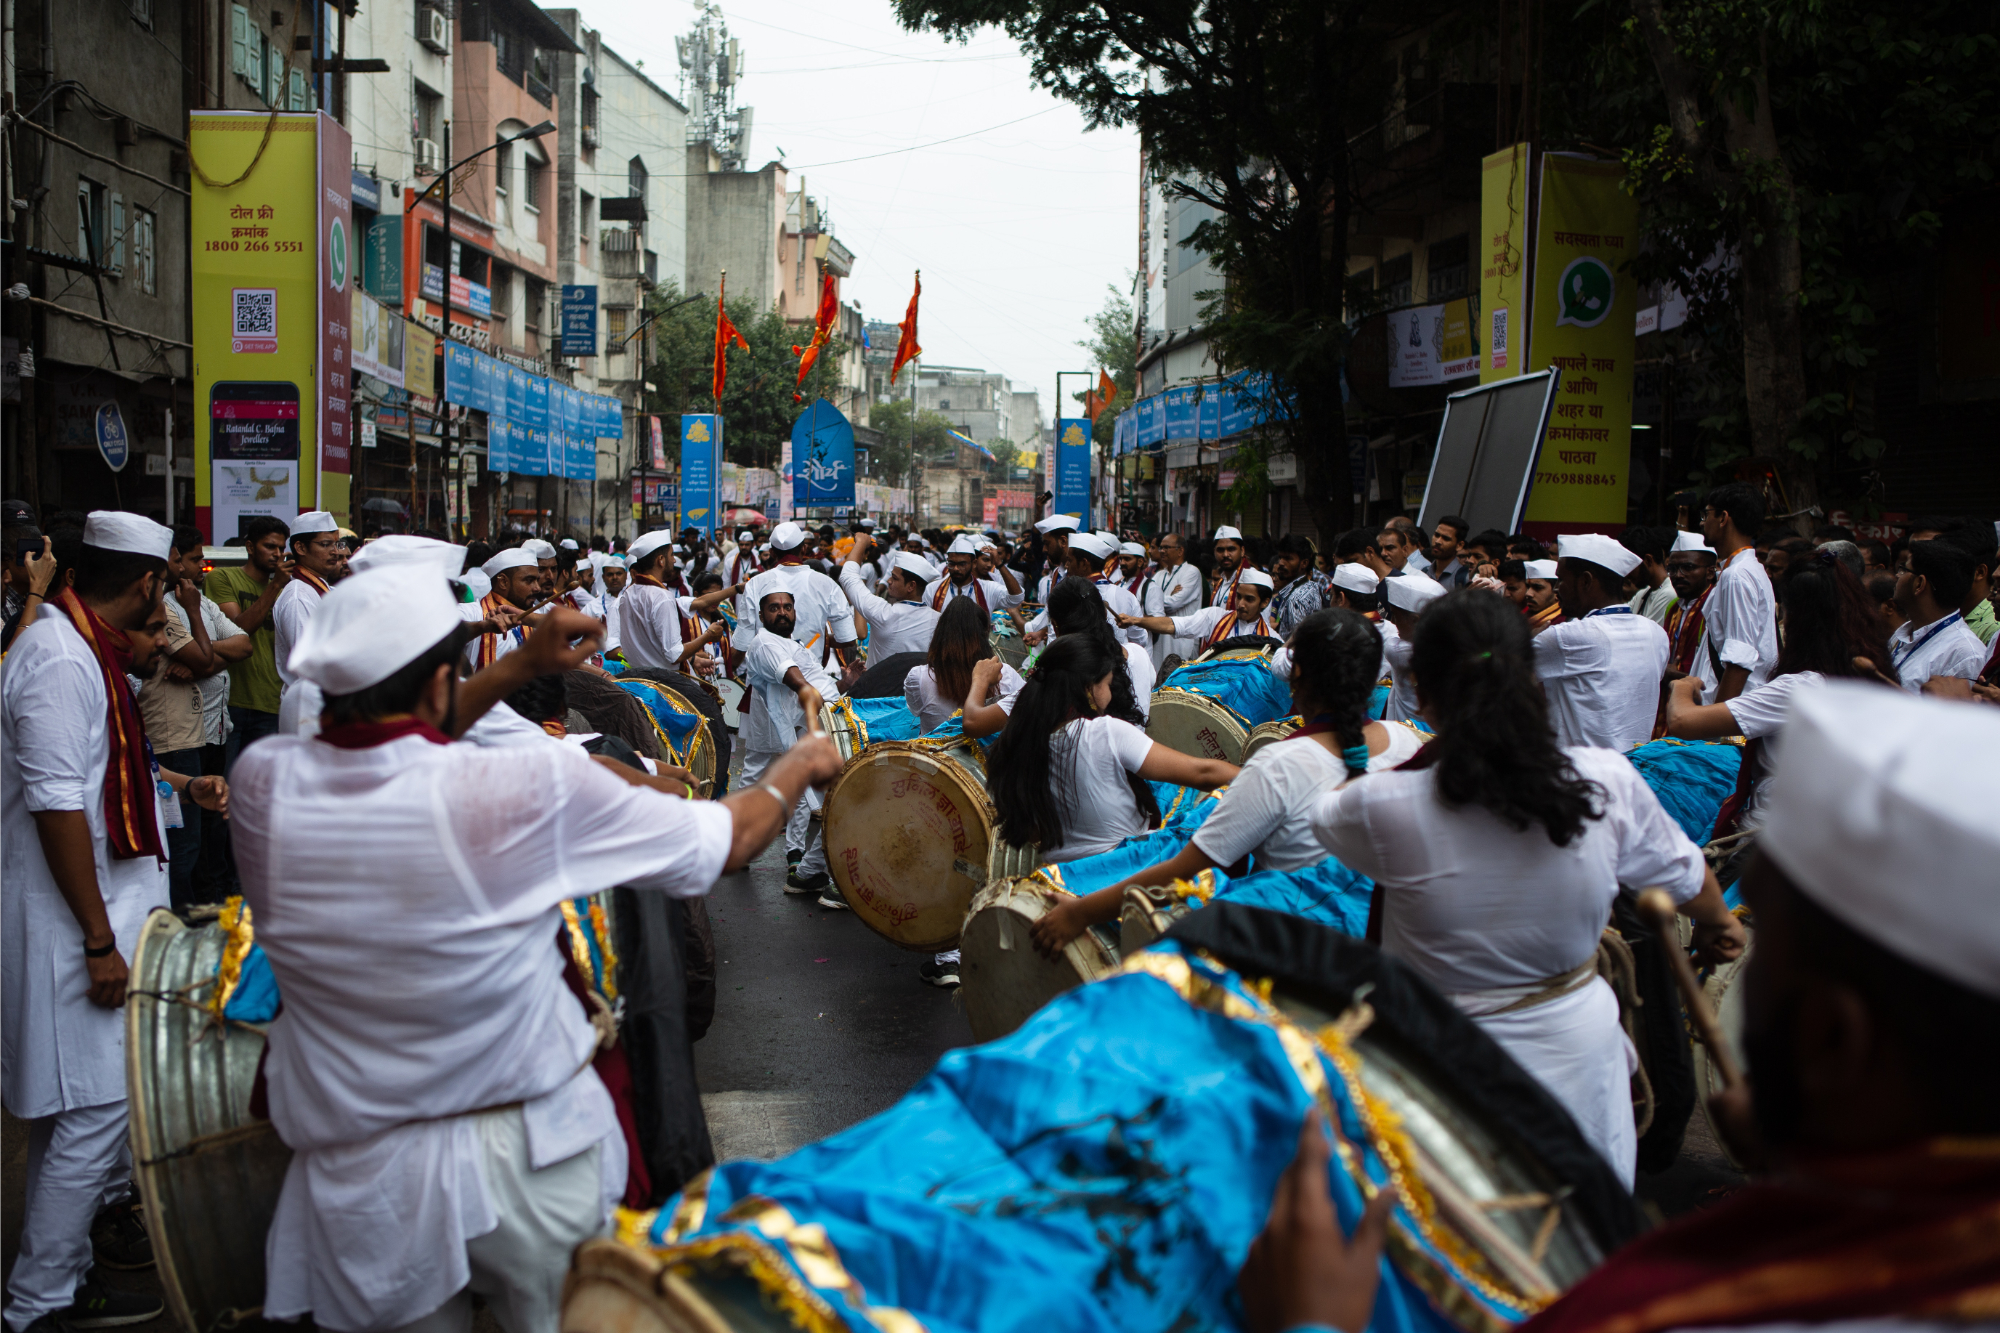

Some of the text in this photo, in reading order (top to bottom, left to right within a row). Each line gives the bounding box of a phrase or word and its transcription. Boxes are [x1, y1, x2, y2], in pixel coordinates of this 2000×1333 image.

[230, 204, 274, 220] टोल फ्री
[231, 224, 268, 239] क्रमांक
[205, 241, 303, 253] 1800 266 5551
[1554, 231, 1624, 249] सदस्यता घ्या
[1552, 352, 1615, 373] आपले नाव
[1565, 377, 1598, 396] आणि
[1558, 404, 1603, 420] शहर या
[226, 422, 285, 438] Ratanlal C. Bafna
[1549, 424, 1610, 443] क्रमांकावर
[114, 439, 124, 447] CYCLE
[240, 433, 269, 446] Jewellers
[107, 447, 123, 455] PARKING
[1559, 450, 1596, 466] पाठवा
[1536, 472, 1616, 486] 7769888845
[660, 485, 674, 496] P1
[648, 505, 662, 515] P1
[1196, 726, 1220, 752] सुनिल
[891, 772, 940, 800] सुनिल
